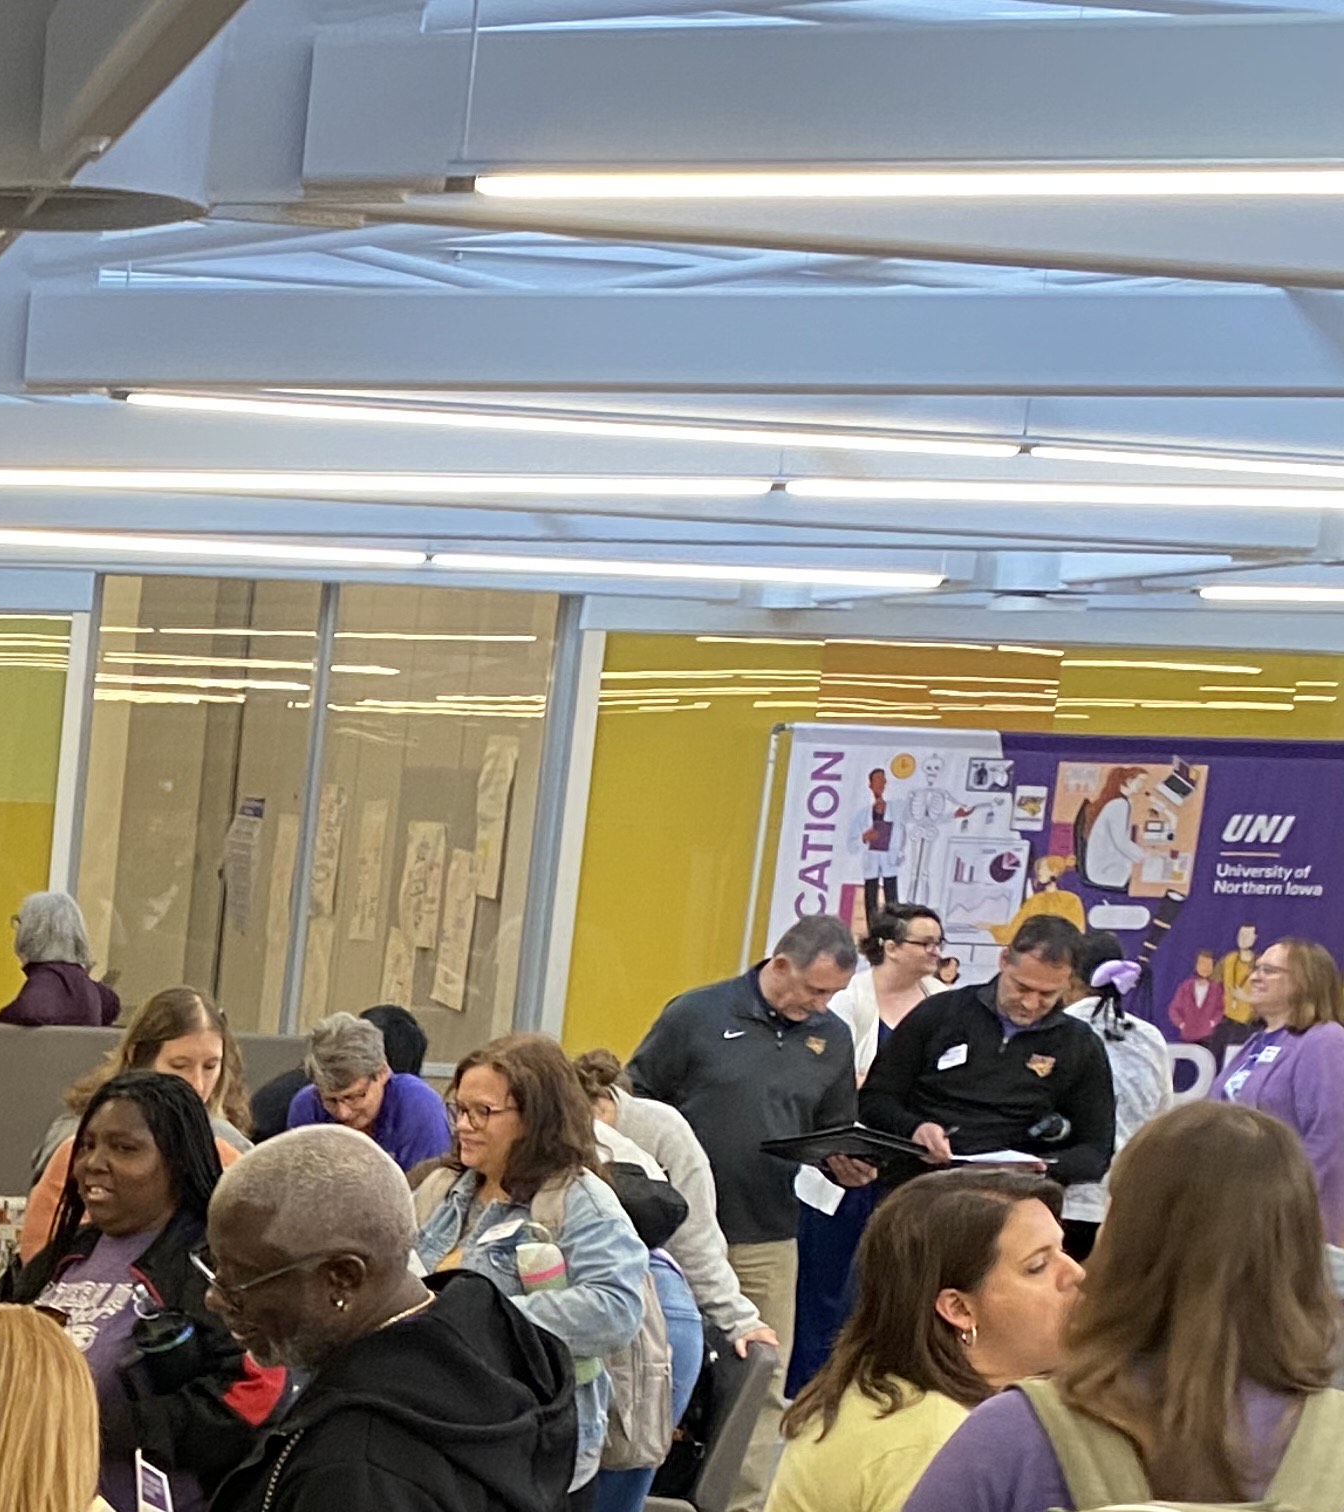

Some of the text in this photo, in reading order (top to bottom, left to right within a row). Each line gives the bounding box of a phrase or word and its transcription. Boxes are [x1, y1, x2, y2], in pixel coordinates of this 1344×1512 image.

[794, 751, 845, 918] CATION
[1221, 814, 1296, 843] UNI
[1216, 863, 1311, 881] University of
[1214, 880, 1323, 896] Northern Iowa
